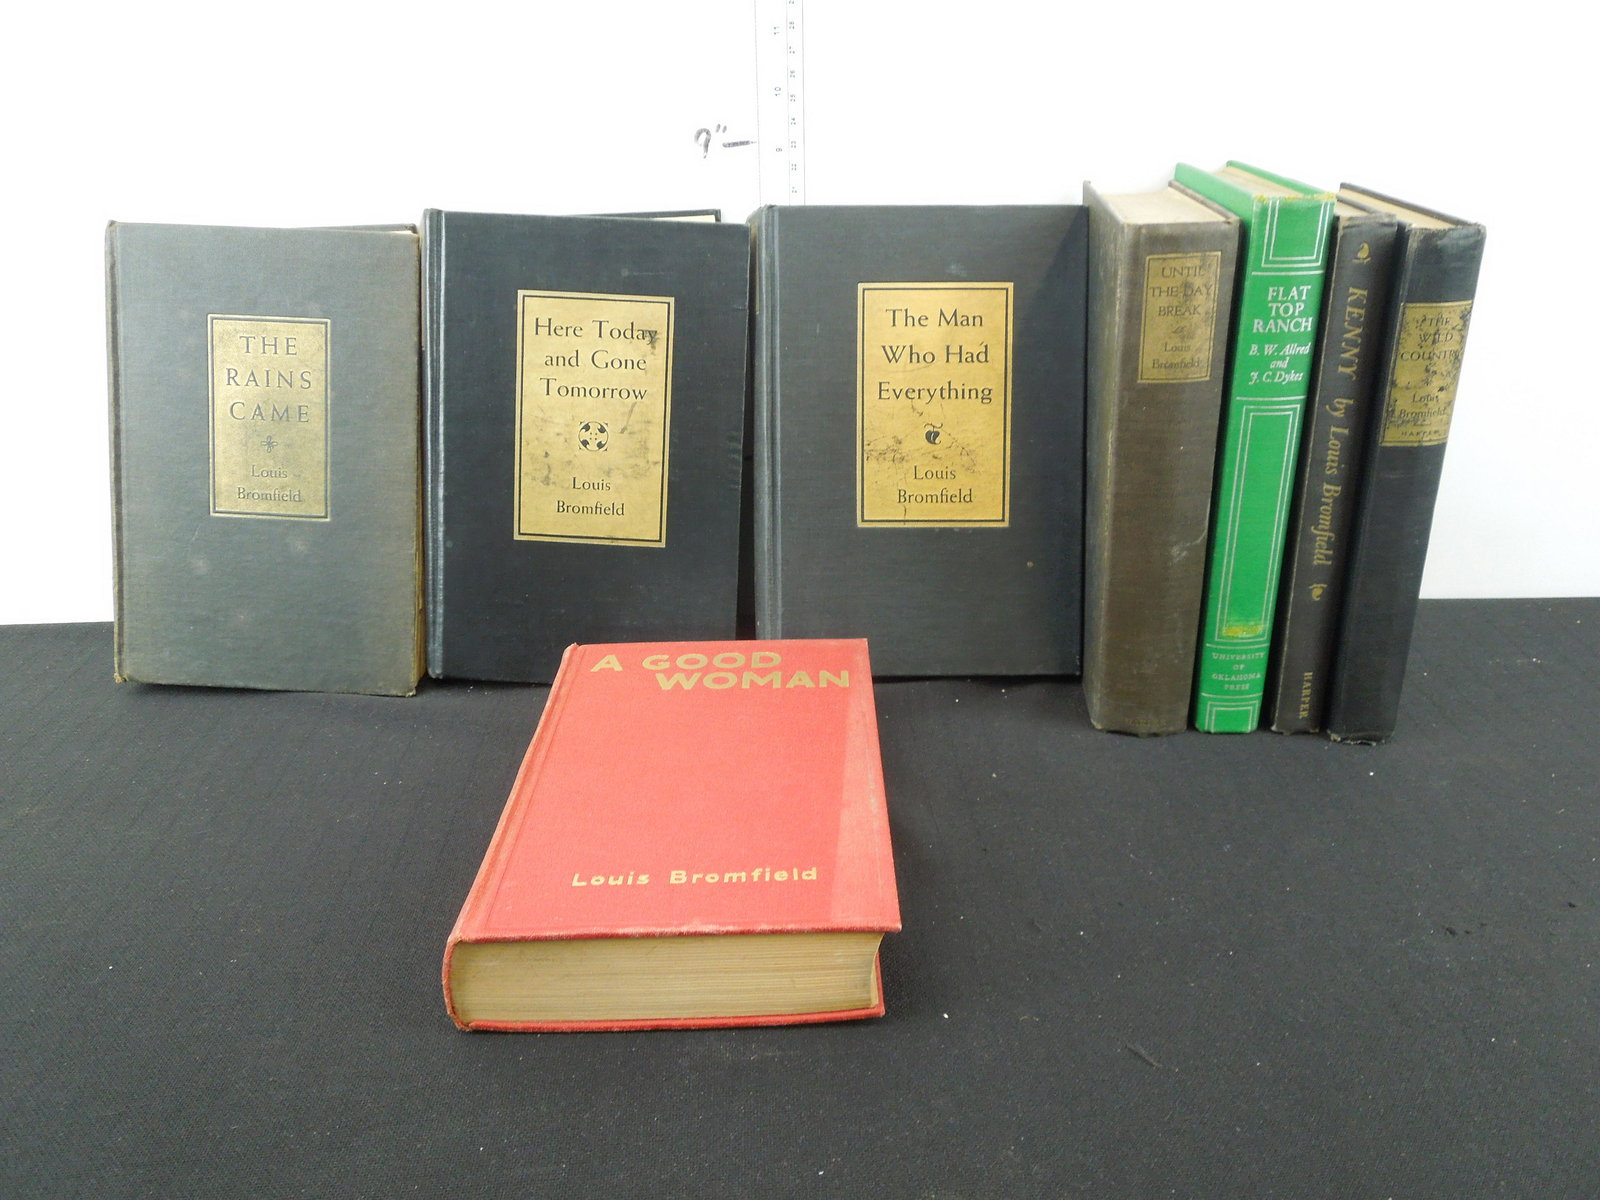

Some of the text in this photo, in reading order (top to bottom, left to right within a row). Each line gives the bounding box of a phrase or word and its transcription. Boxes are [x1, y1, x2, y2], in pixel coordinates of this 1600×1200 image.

[774, 87, 781, 97] 10
[1161, 265, 1206, 278] UNTIL
[1150, 284, 1213, 298] THE DAY
[1268, 285, 1312, 300] FLAT
[886, 308, 984, 328] The Man
[1158, 305, 1201, 317] BREAK
[1268, 302, 1304, 317] TOP
[534, 317, 658, 346] Here Today
[1252, 316, 1313, 333] RANCH
[240, 336, 298, 356] THE
[882, 344, 990, 364] Who Had
[1249, 342, 1312, 356] B. W. Allred
[544, 350, 647, 370] and Gone
[1270, 356, 1290, 369] and
[226, 368, 312, 390] RAINS
[1262, 371, 1272, 383] C.
[1274, 370, 1304, 385] Dykes
[540, 377, 648, 401] Tomorrow
[878, 380, 993, 405] Everything
[230, 402, 310, 423] CAME
[1311, 286, 1368, 566] KENNY by Louis Bromfield
[251, 464, 288, 479] Louis
[914, 465, 956, 480] Louis
[572, 476, 612, 492] Louis
[237, 486, 302, 503] Bromfield
[897, 488, 973, 504] Bromfield
[556, 500, 625, 517] Bromfield
[590, 652, 782, 672] A GOOD
[1212, 652, 1266, 660] UNIVERSITY
[655, 670, 850, 690] WOMAN
[1212, 672, 1261, 680] OKLAHOMA
[1299, 672, 1314, 720] HARPER
[572, 867, 818, 886] Louis Bromfield
